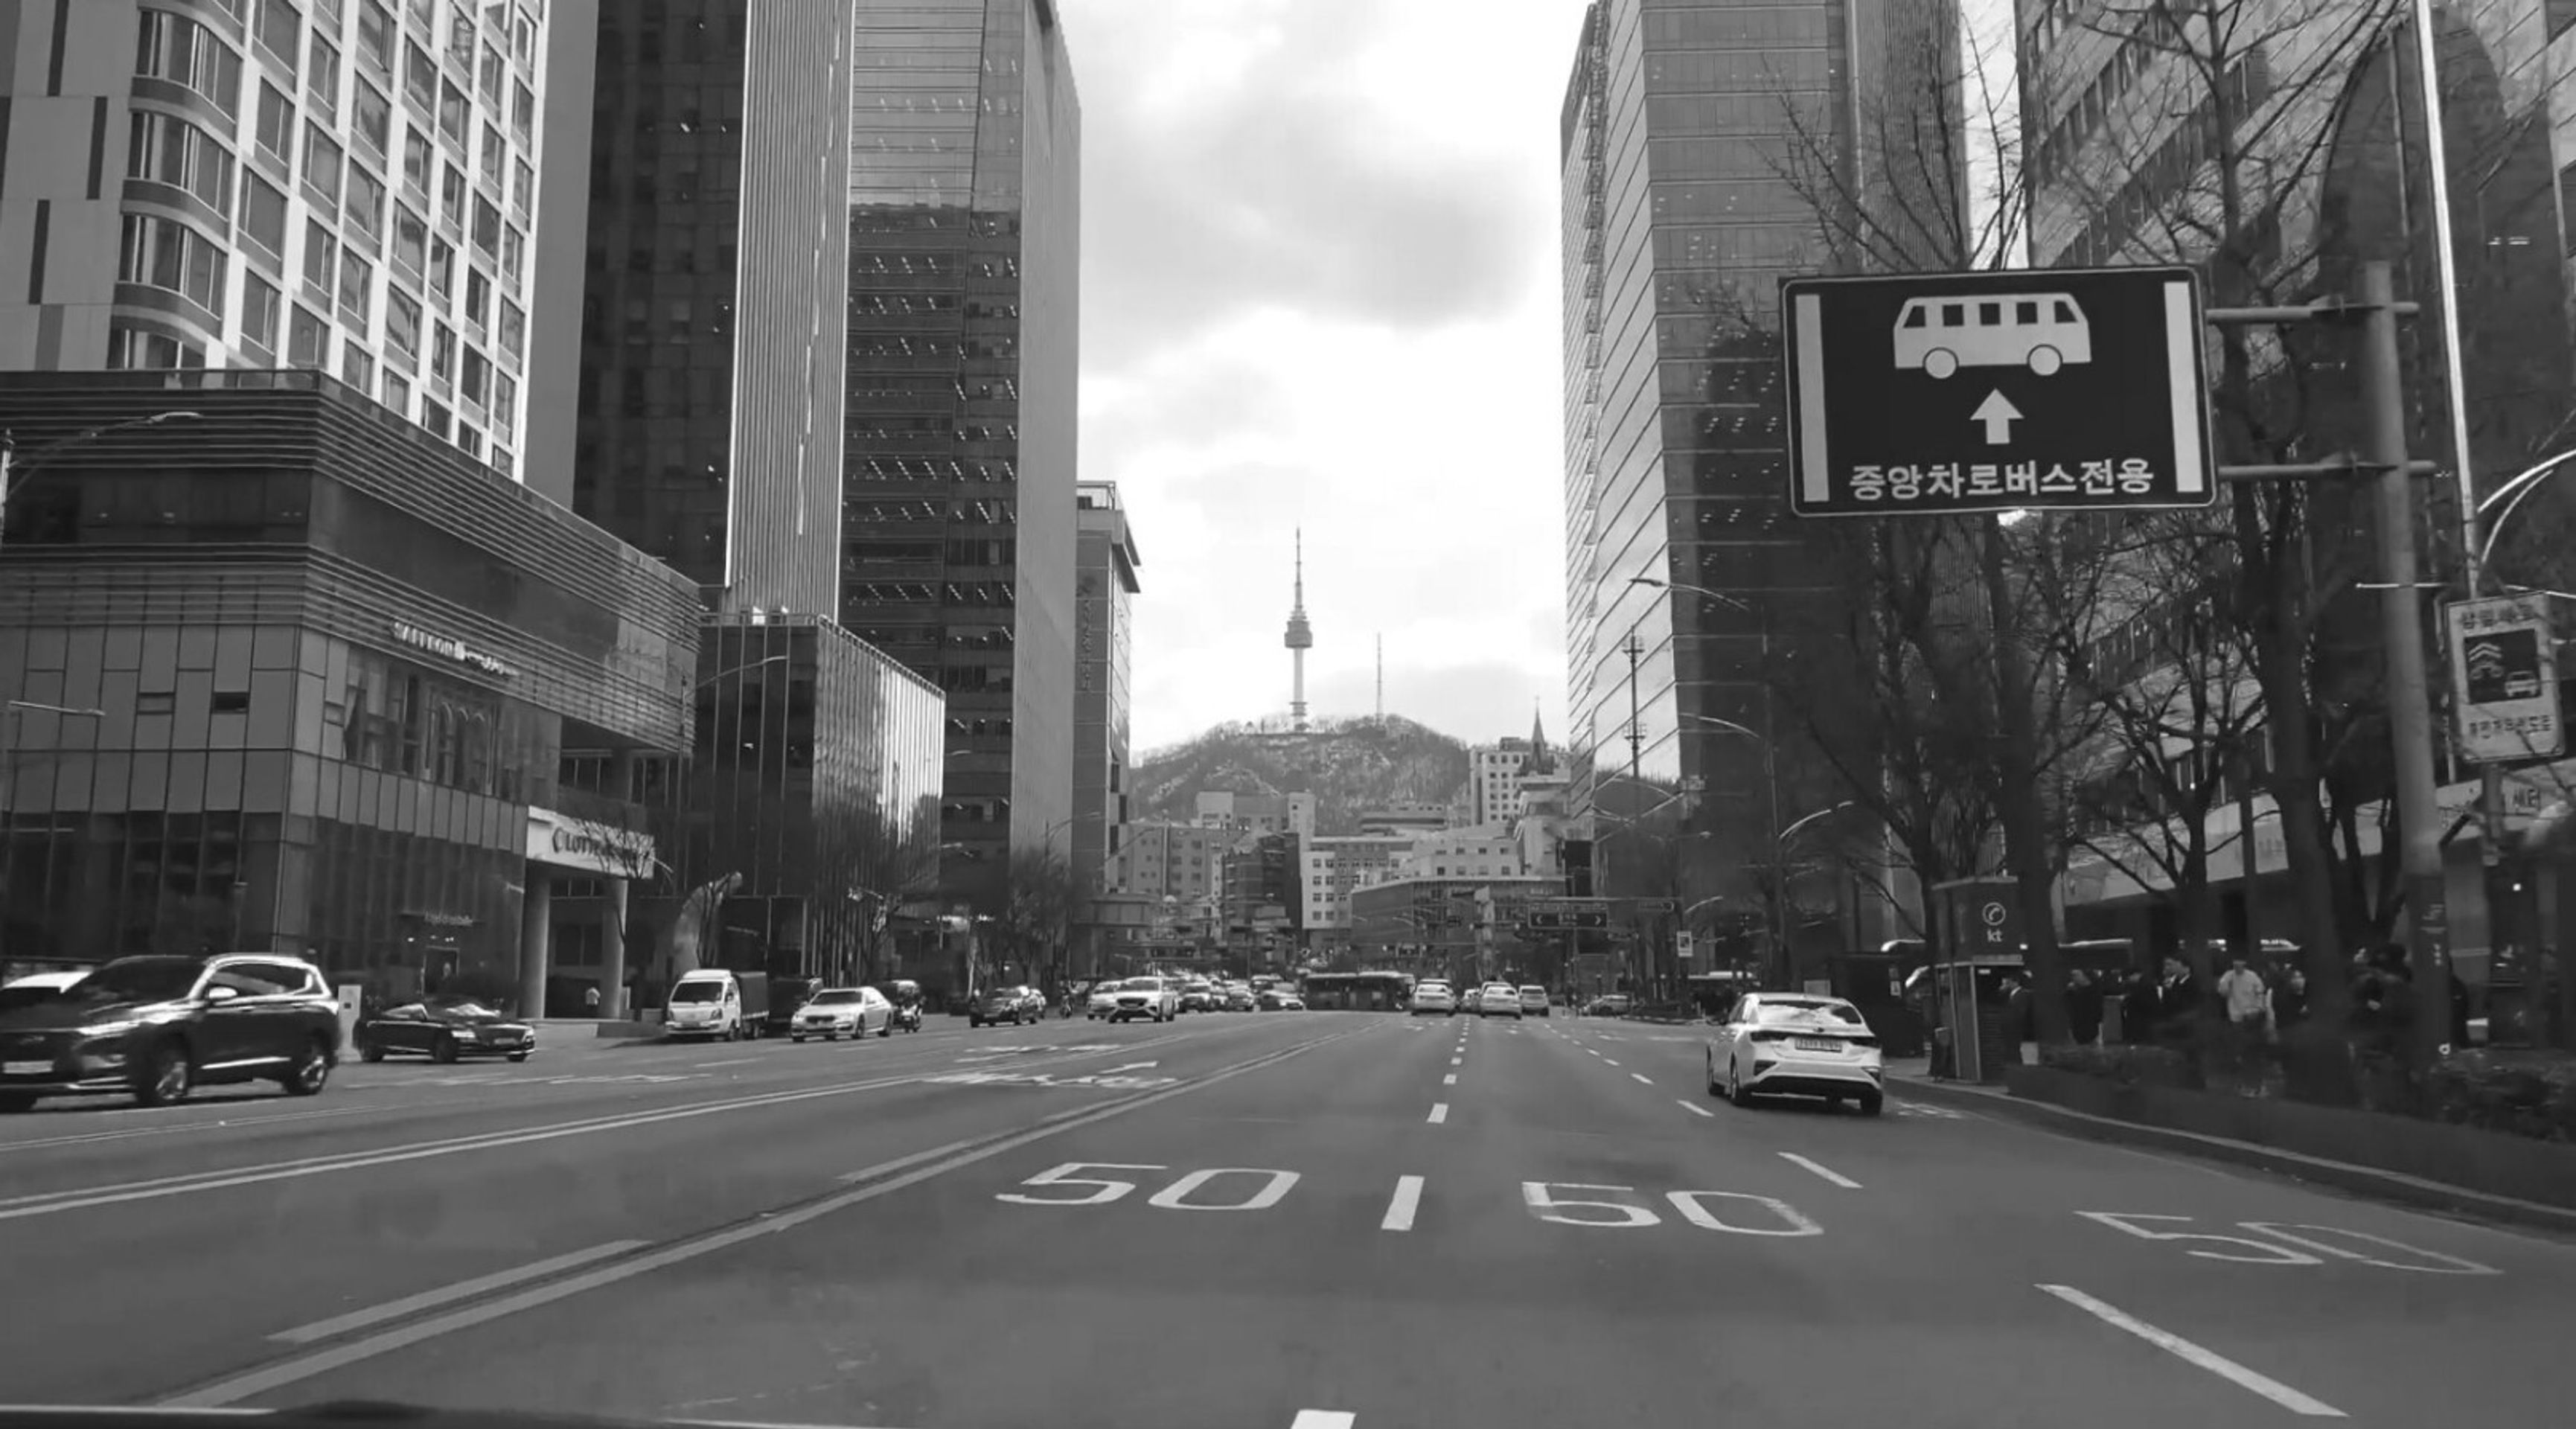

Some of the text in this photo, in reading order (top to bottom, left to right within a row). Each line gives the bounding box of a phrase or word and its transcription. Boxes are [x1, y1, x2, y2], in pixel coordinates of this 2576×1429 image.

[1849, 458, 2153, 501] 중앙차로버스전용
[1987, 929, 2003, 942] kt
[995, 1163, 1300, 1210] 50
[1521, 1181, 1824, 1235] 50
[2074, 1210, 2504, 1274] 50
